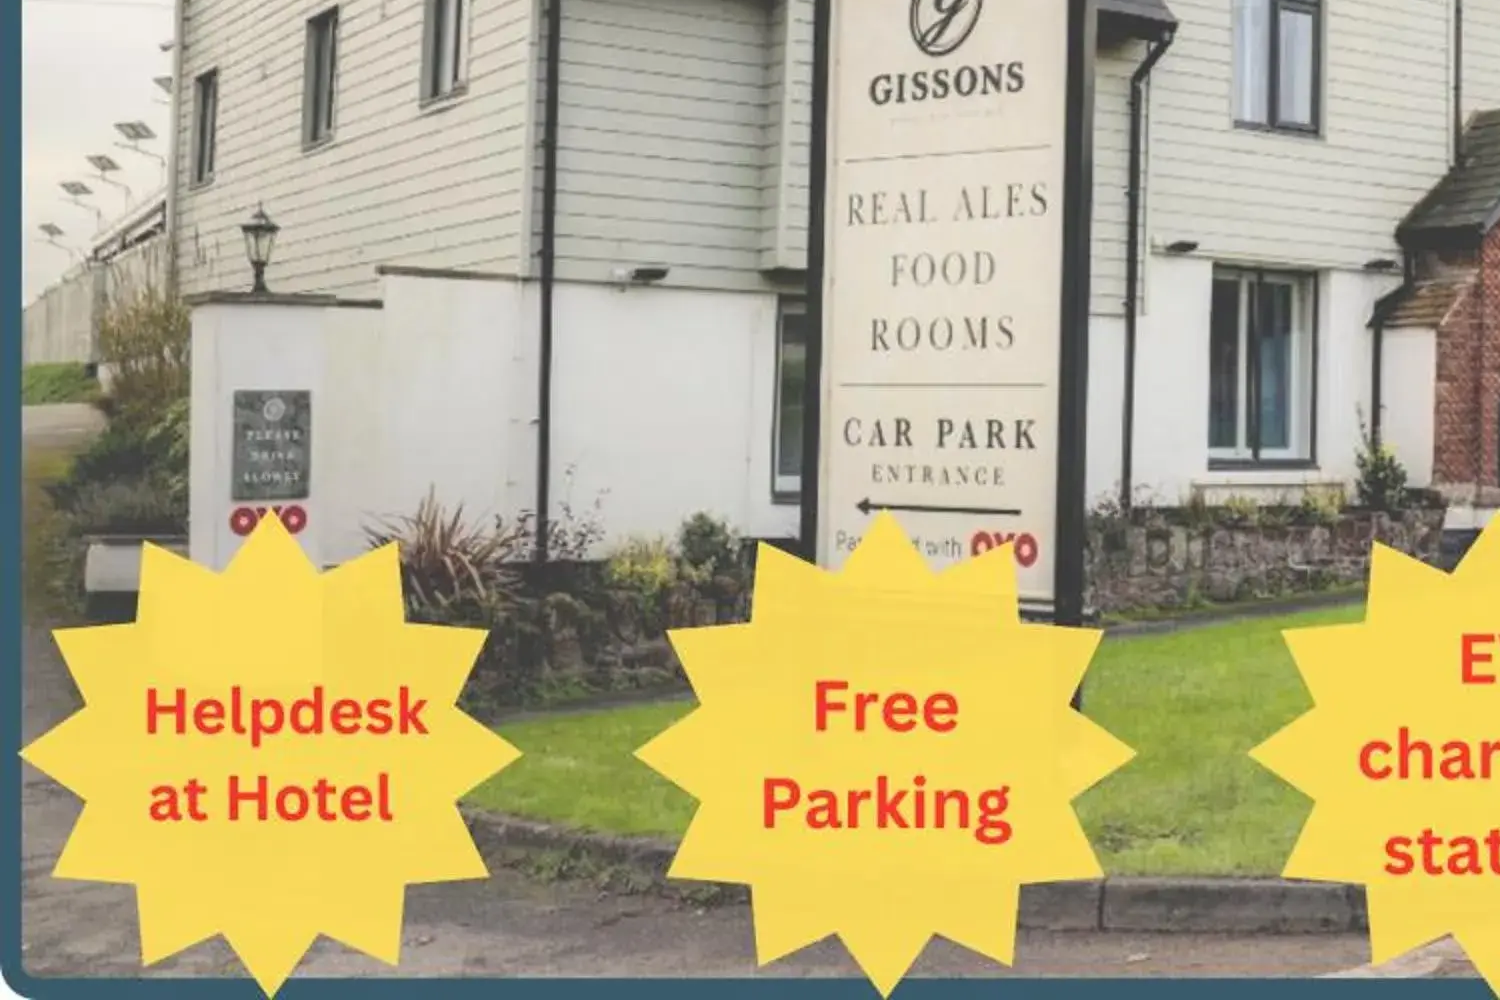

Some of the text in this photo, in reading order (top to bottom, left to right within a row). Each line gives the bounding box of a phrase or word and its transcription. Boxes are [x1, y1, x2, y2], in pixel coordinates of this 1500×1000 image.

[868, 61, 1025, 106] GISSONS
[848, 180, 1049, 227] REAL ALES
[891, 251, 996, 287] FOOD
[870, 315, 1014, 351] ROOMS
[843, 416, 1037, 450] CAR PARK
[871, 463, 1006, 486] ENTRANCE
